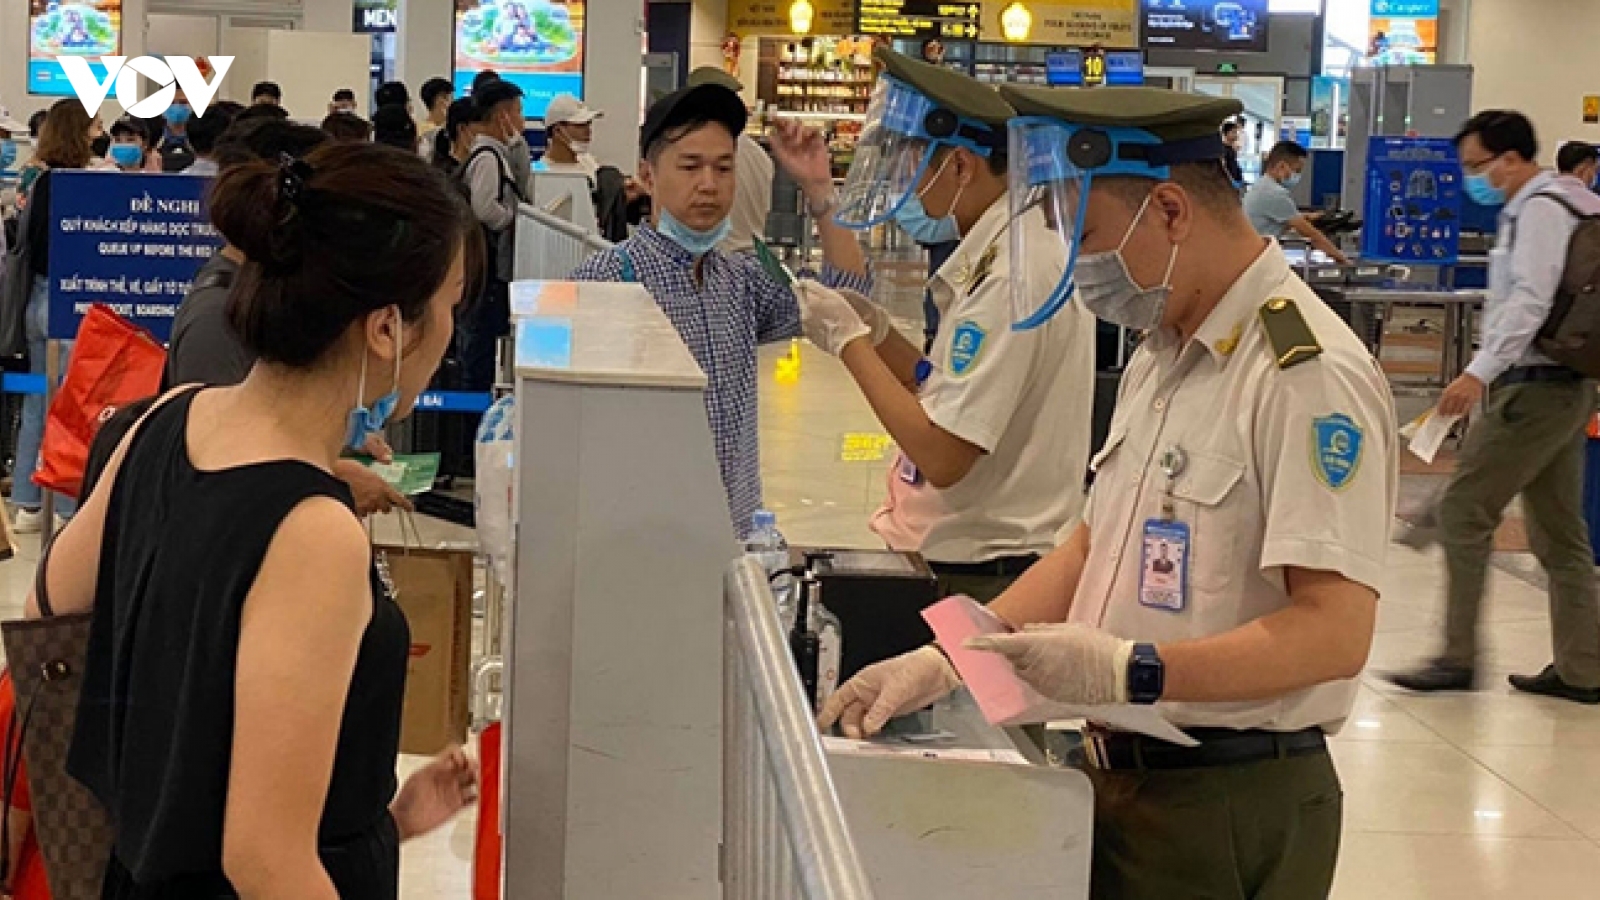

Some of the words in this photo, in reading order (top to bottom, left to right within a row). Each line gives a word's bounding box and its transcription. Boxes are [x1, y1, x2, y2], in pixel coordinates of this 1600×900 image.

[364, 9, 398, 27] MEN
[1085, 56, 1102, 75] 10
[131, 190, 153, 213] ĐỀ
[157, 200, 200, 216] NGHỊ
[60, 215, 82, 231] QUÝ
[83, 216, 118, 232] KHÁCH
[139, 217, 167, 236] HÀNG
[169, 221, 190, 238] DỌC
[97, 241, 128, 255] QUEUE
[129, 242, 143, 255] UP
[144, 243, 175, 256] BEFORE
[178, 244, 193, 257] THE
[136, 304, 175, 316] BOARDING
